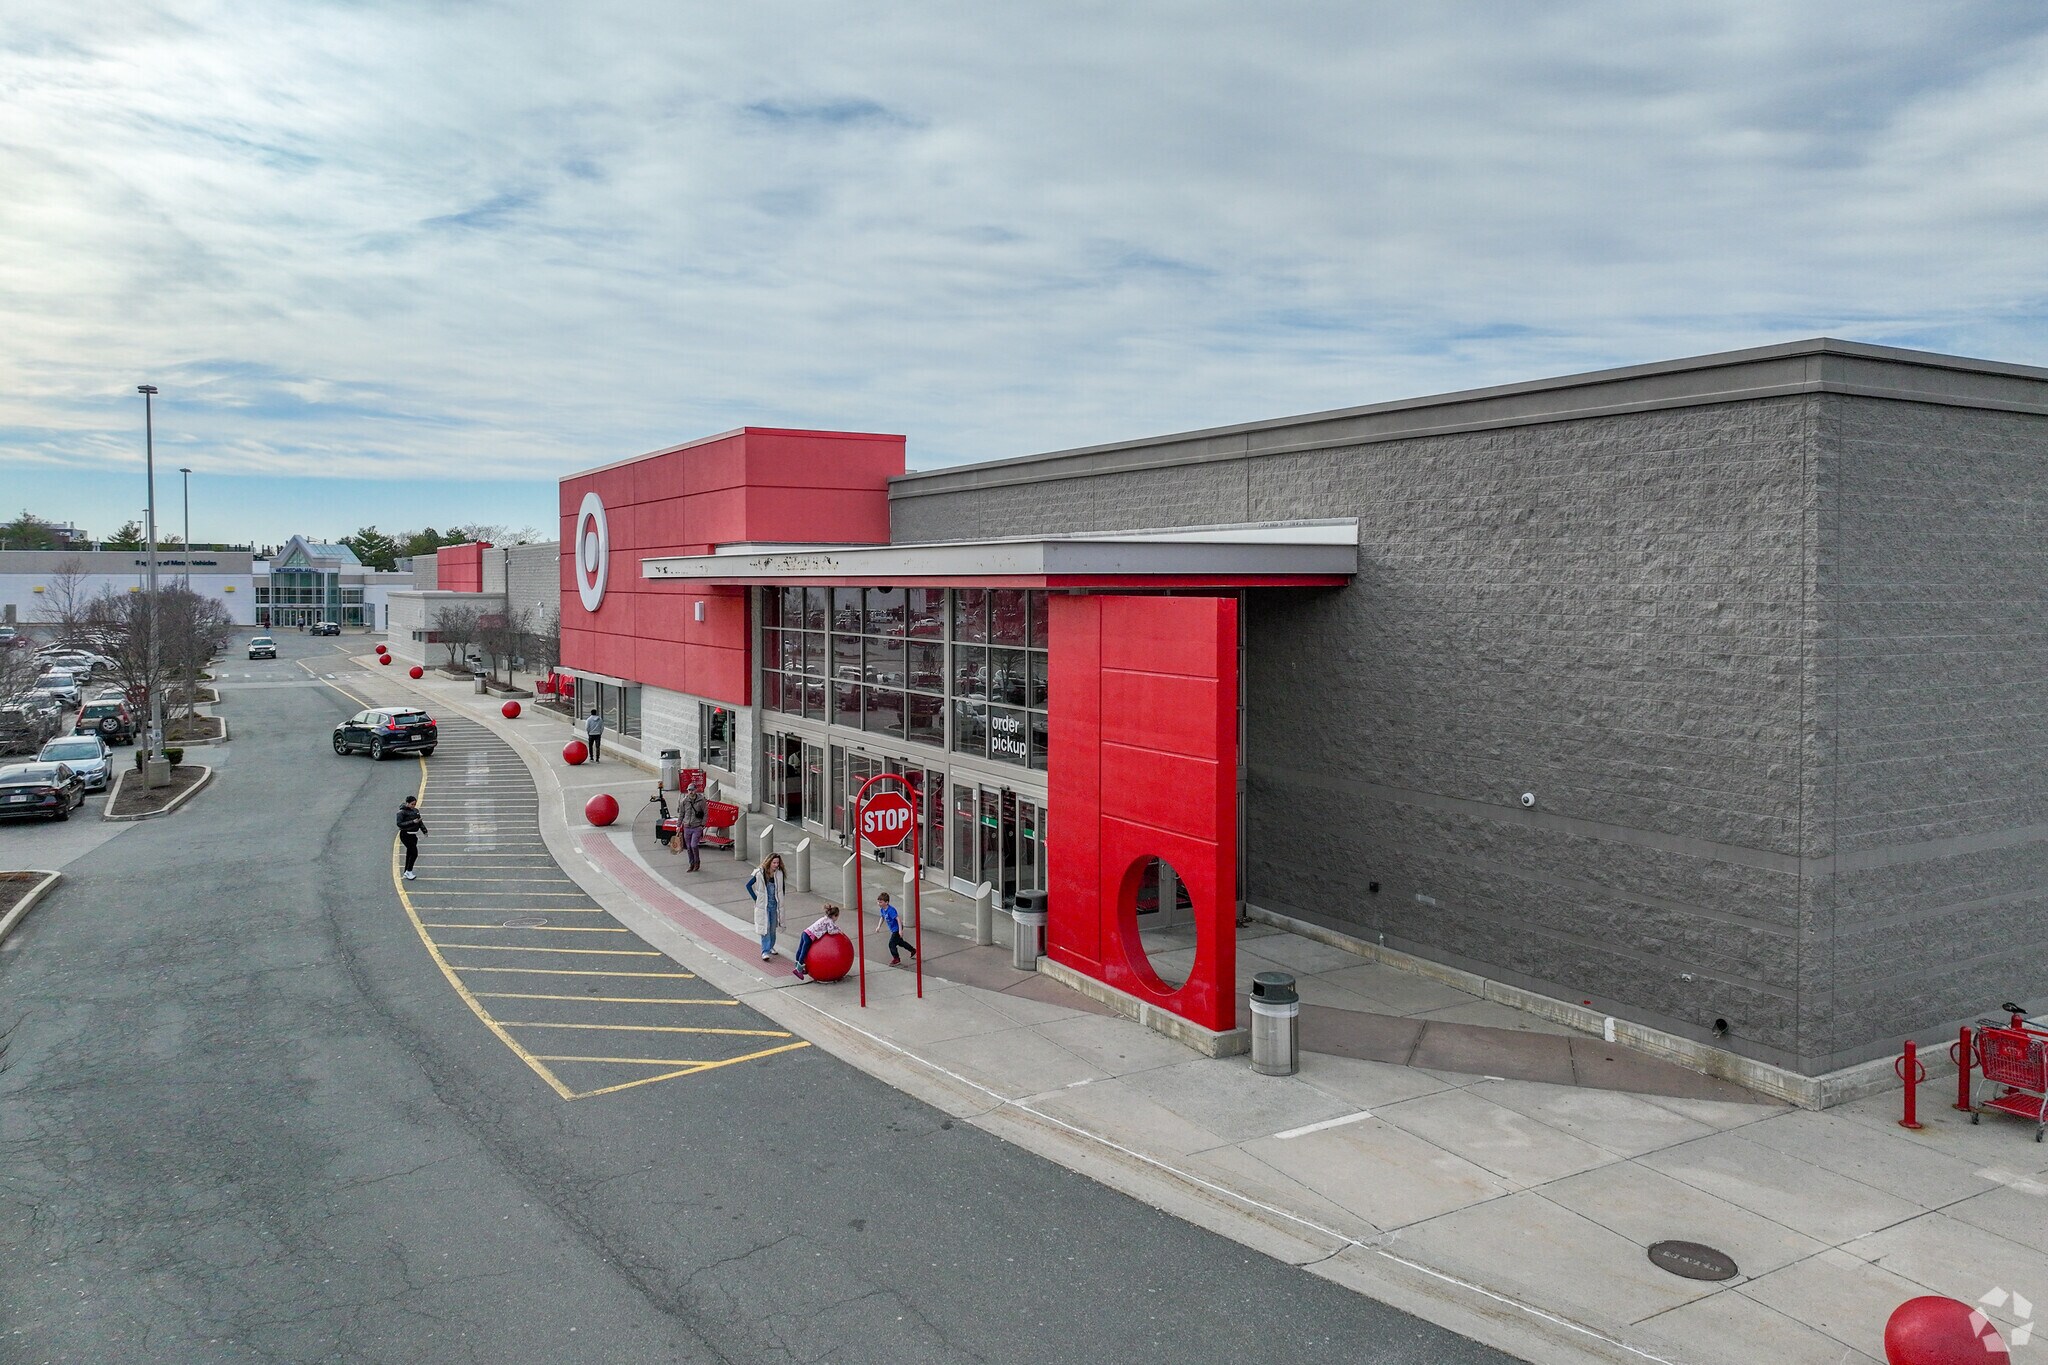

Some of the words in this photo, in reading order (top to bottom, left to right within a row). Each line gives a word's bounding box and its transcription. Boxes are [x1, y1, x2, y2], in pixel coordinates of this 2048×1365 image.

[992, 715, 1020, 733] order
[992, 734, 1027, 759] pickup
[864, 808, 909, 833] STOP
